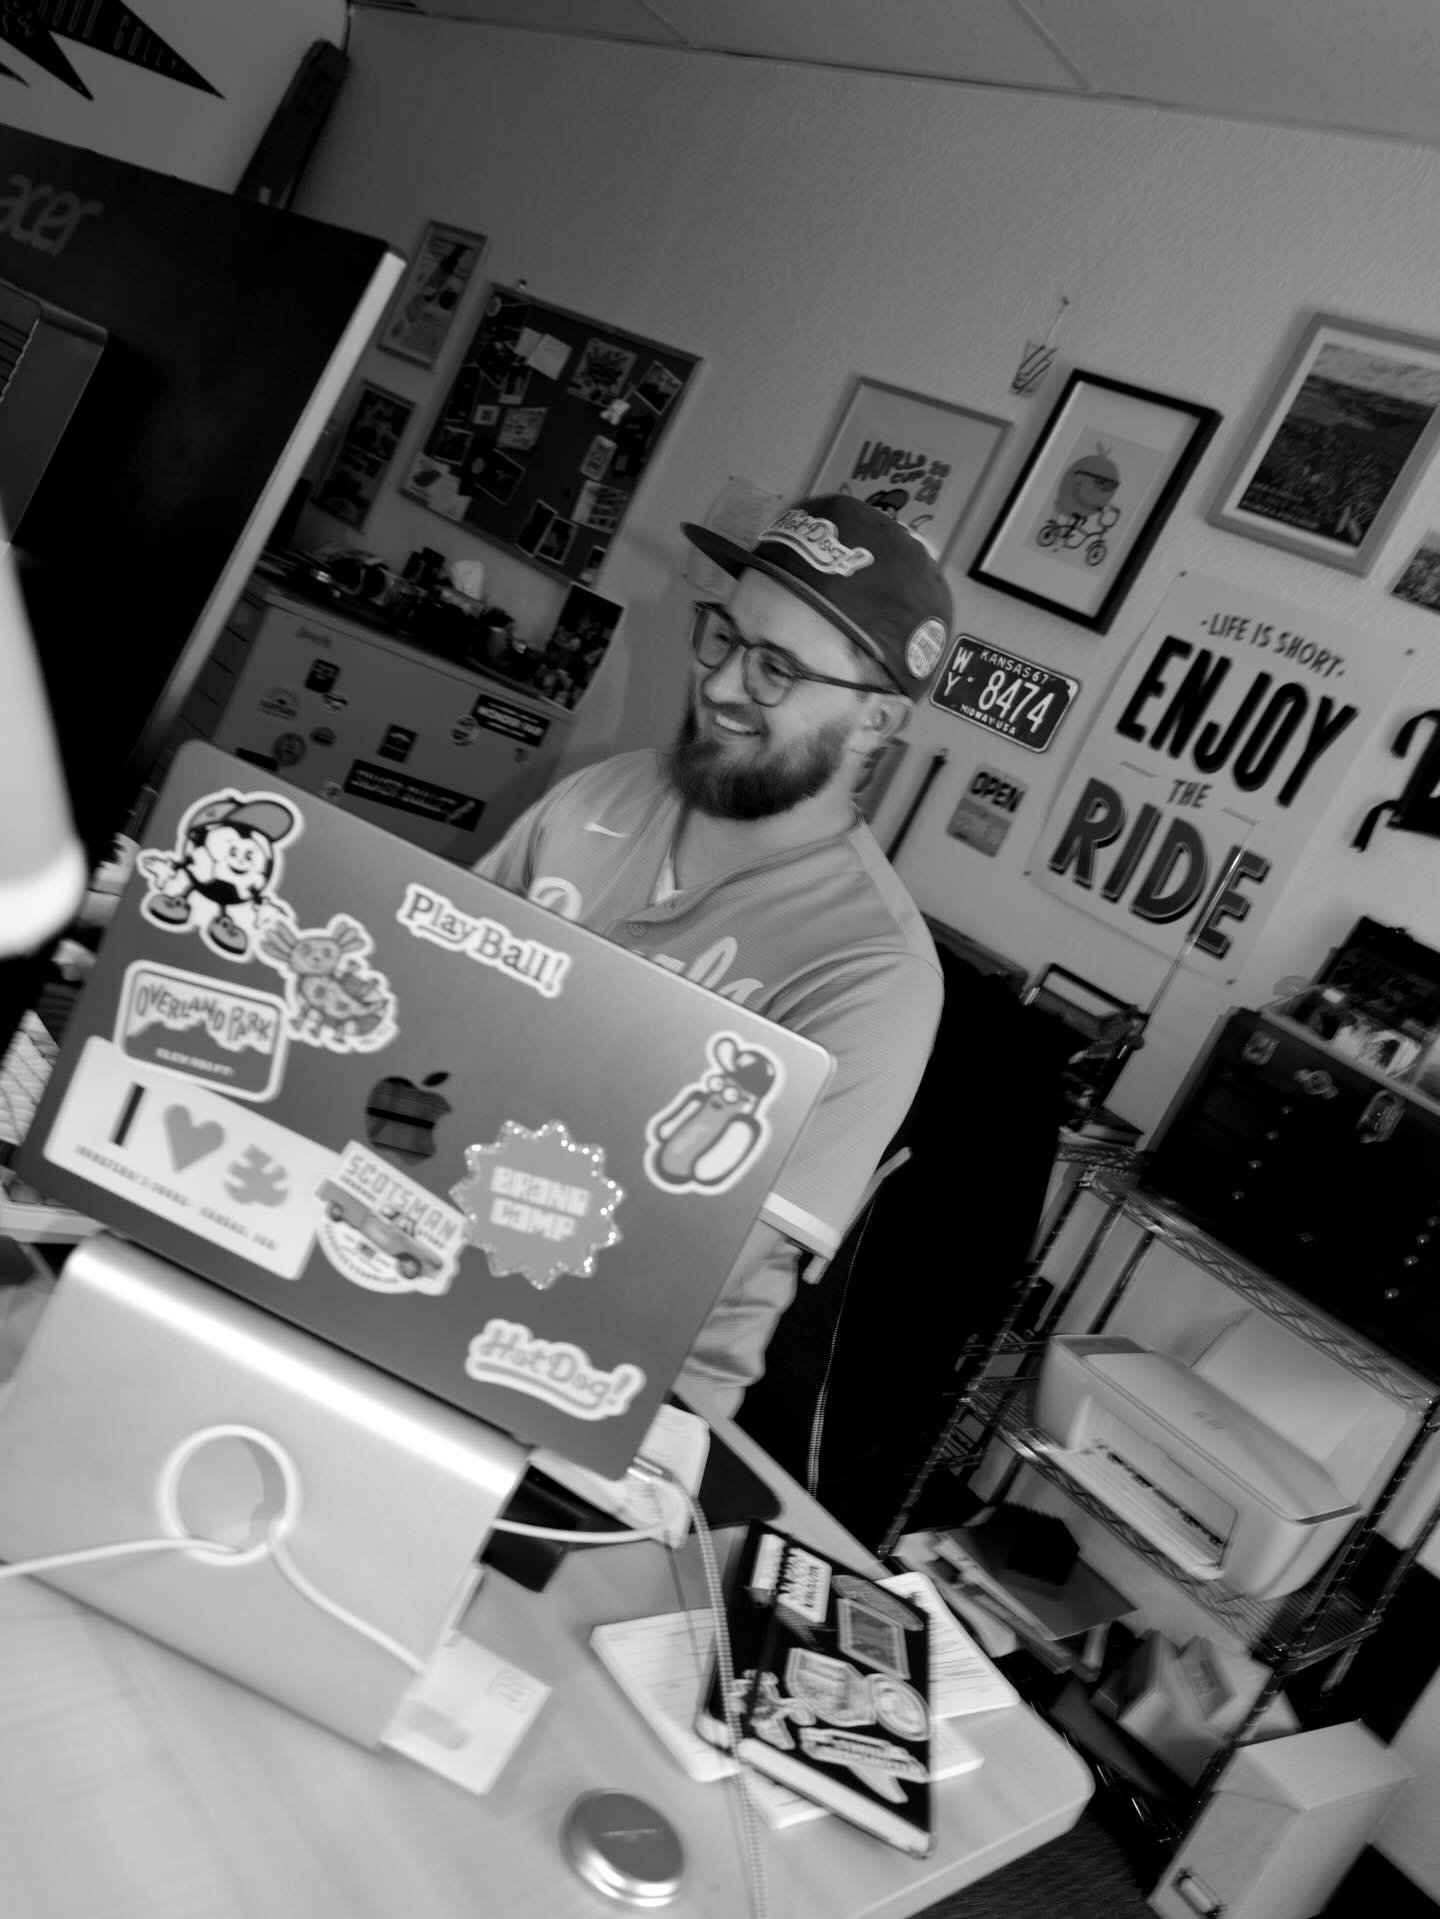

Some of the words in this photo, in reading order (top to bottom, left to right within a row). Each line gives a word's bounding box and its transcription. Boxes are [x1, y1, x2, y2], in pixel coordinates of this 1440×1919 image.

[0, 174, 104, 256] acer
[851, 441, 927, 481] WORLD
[980, 649, 1032, 678] KANSAS
[1032, 670, 1049, 685] 67
[1208, 613, 1250, 641] LIFE
[1250, 621, 1274, 648] IS
[1274, 631, 1345, 678] SHORT
[960, 704, 996, 725] MIDWAY
[995, 721, 1017, 735] USA
[978, 670, 1055, 733] 8474
[1115, 635, 1360, 809] ENJOY
[970, 771, 1026, 813] OPEN
[1167, 779, 1213, 808] THE
[1047, 777, 1273, 961] RIDE
[136, 983, 225, 1031] OVERLAND
[227, 1006, 272, 1042] PARK
[111, 1081, 146, 1146] I
[345, 1155, 459, 1241] SCOTSMAN
